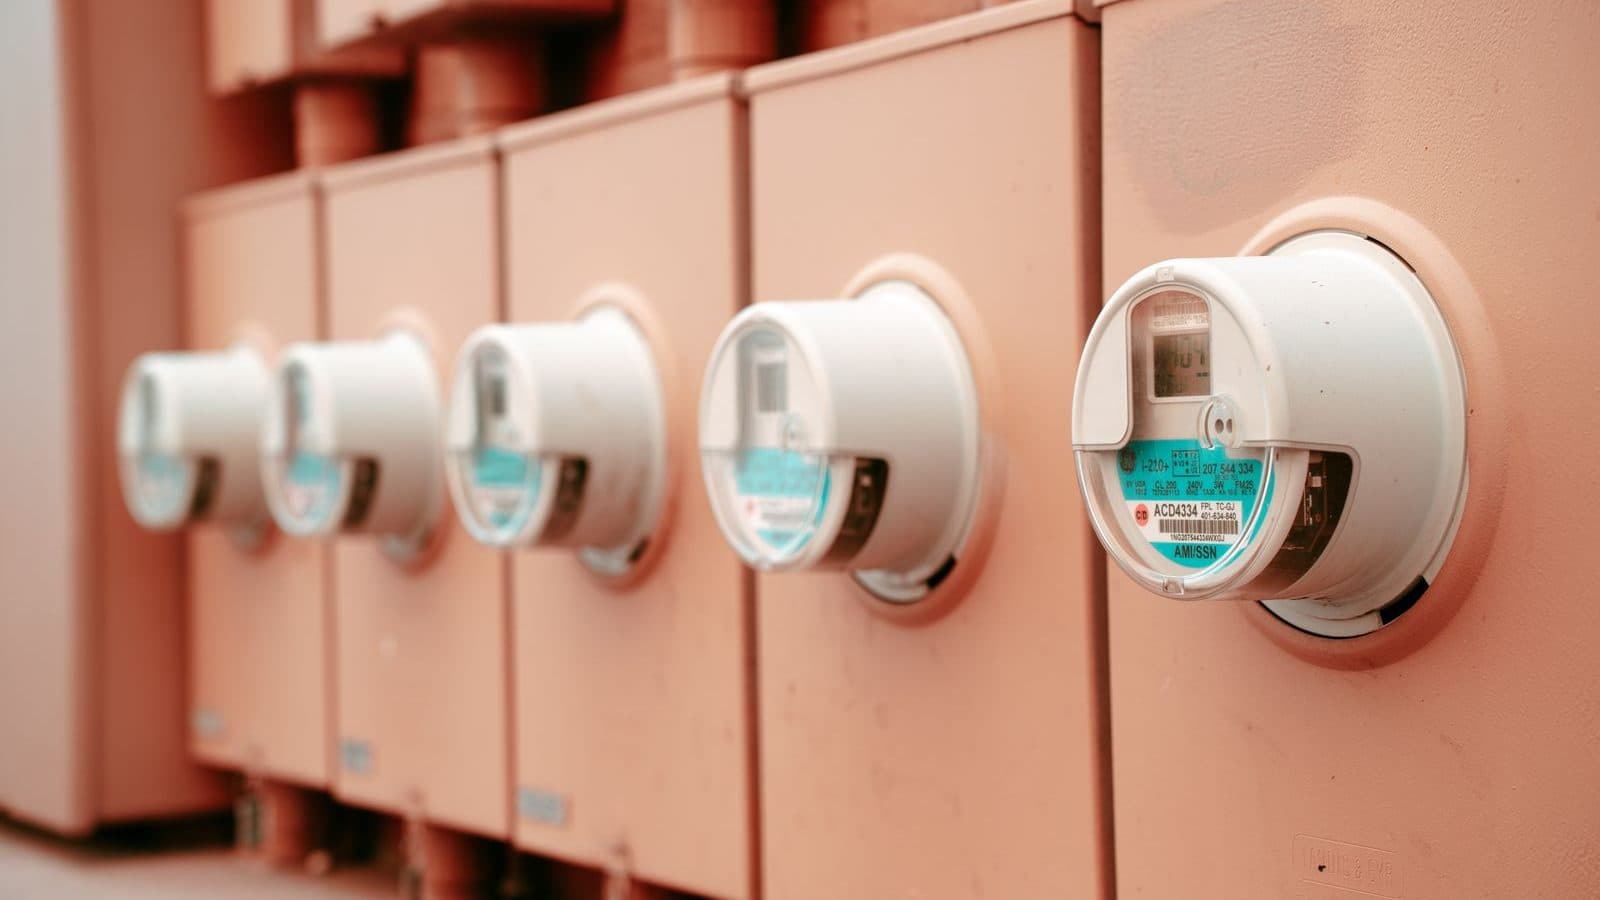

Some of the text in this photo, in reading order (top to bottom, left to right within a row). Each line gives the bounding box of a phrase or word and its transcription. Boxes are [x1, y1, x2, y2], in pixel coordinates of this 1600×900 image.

[1202, 463, 1217, 475] 207
[1220, 463, 1236, 475] 544
[1238, 463, 1254, 475] 334
[1153, 503, 1198, 518] ACD4334
[1200, 502, 1213, 511] FPL
[1174, 545, 1217, 559] AMI/SSN
